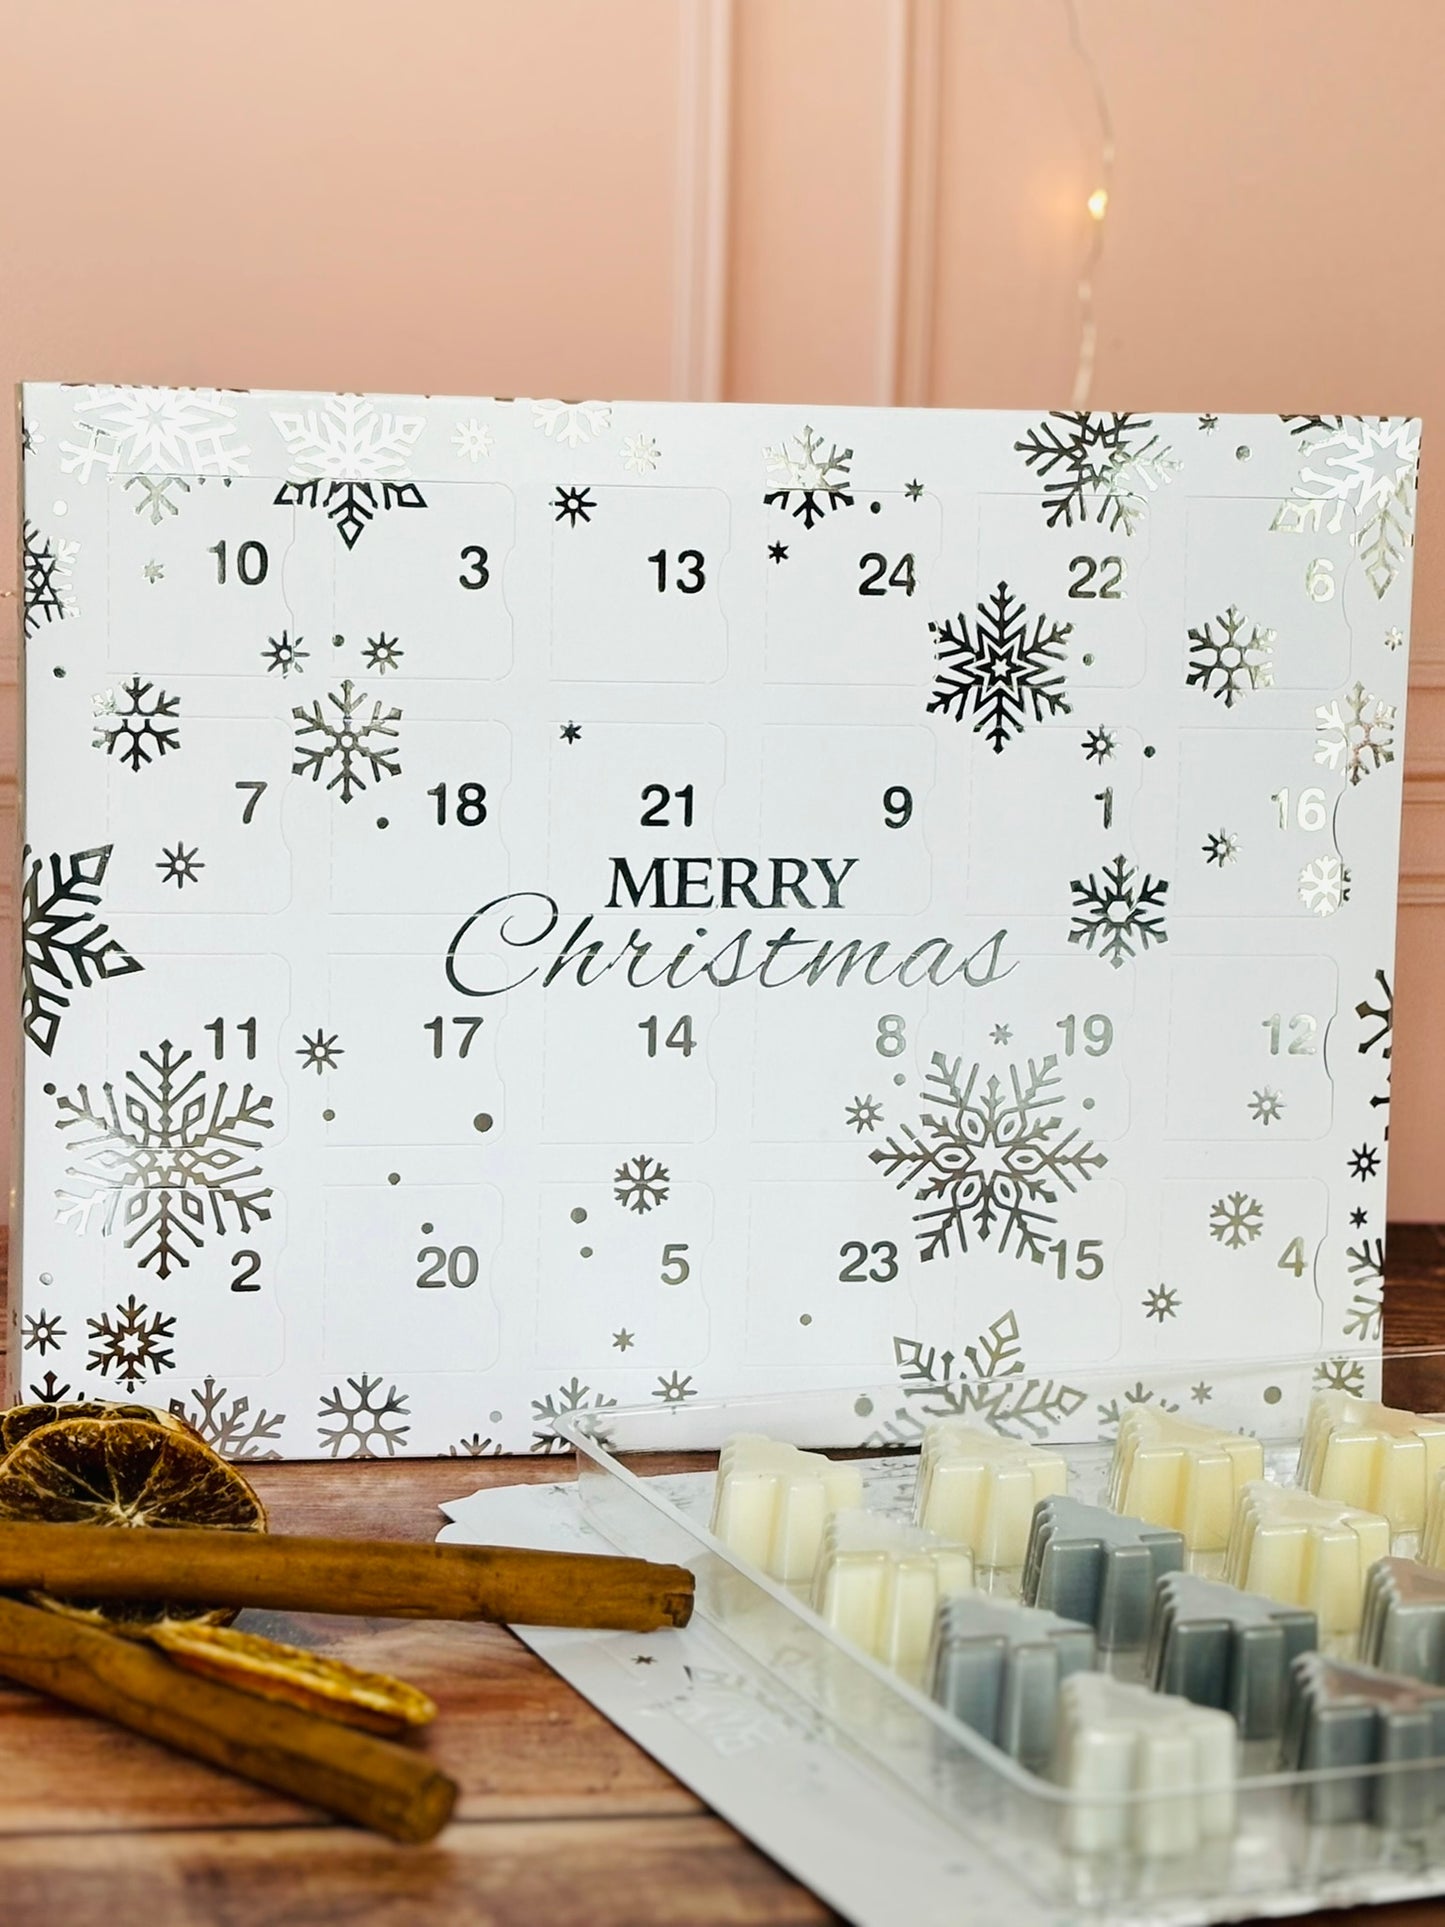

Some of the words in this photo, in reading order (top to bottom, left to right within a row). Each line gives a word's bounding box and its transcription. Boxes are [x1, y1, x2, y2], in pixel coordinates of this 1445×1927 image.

[206, 540, 268, 586] 10
[459, 545, 490, 590] 3
[647, 549, 706, 594] 13
[858, 552, 916, 597] 24
[1068, 555, 1128, 599] 22
[1305, 558, 1335, 602] 6
[235, 781, 268, 824] 7
[427, 782, 487, 827] 18
[640, 783, 694, 827] 21
[883, 786, 913, 829] 9
[1094, 786, 1113, 830] 1
[1271, 787, 1327, 832] 16
[604, 857, 860, 909] MERRY
[445, 892, 1020, 997] Christmas
[204, 1016, 258, 1060] 11
[424, 1016, 484, 1059] 17
[638, 1015, 697, 1058] 14
[876, 1014, 907, 1057] 8
[1056, 1014, 1114, 1057] 19
[1261, 1013, 1318, 1056] 12
[230, 1249, 262, 1292] 2
[416, 1246, 480, 1288] 20
[661, 1244, 690, 1286] 5
[839, 1240, 899, 1283] 23
[1048, 1238, 1104, 1281] 15
[1277, 1236, 1308, 1278] 4
